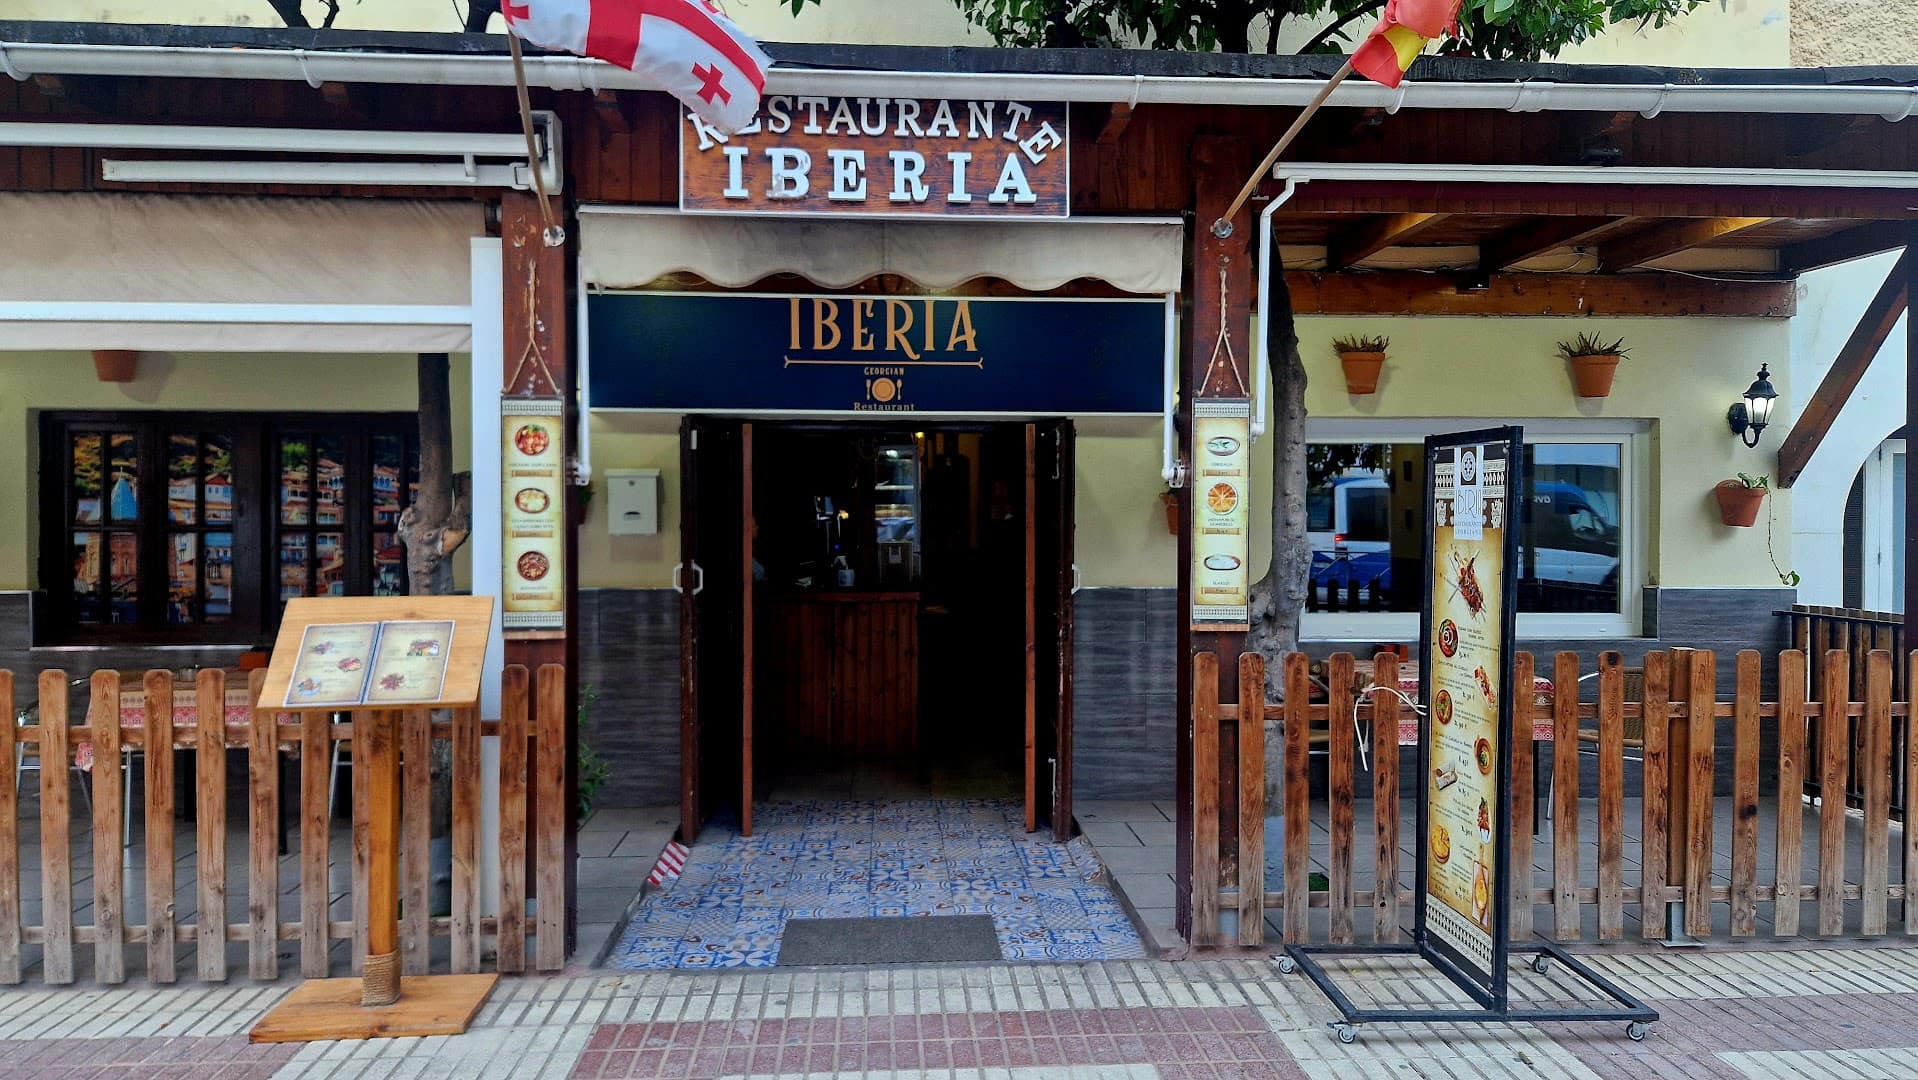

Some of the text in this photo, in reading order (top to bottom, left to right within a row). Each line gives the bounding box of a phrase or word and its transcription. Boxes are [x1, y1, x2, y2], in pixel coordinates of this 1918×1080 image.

[687, 96, 1062, 164] RSTAURANTE
[722, 146, 1037, 204] IBERIA
[789, 298, 978, 360] IBERIA
[864, 367, 905, 376] GEORGIAN
[854, 402, 915, 411] Restaurant
